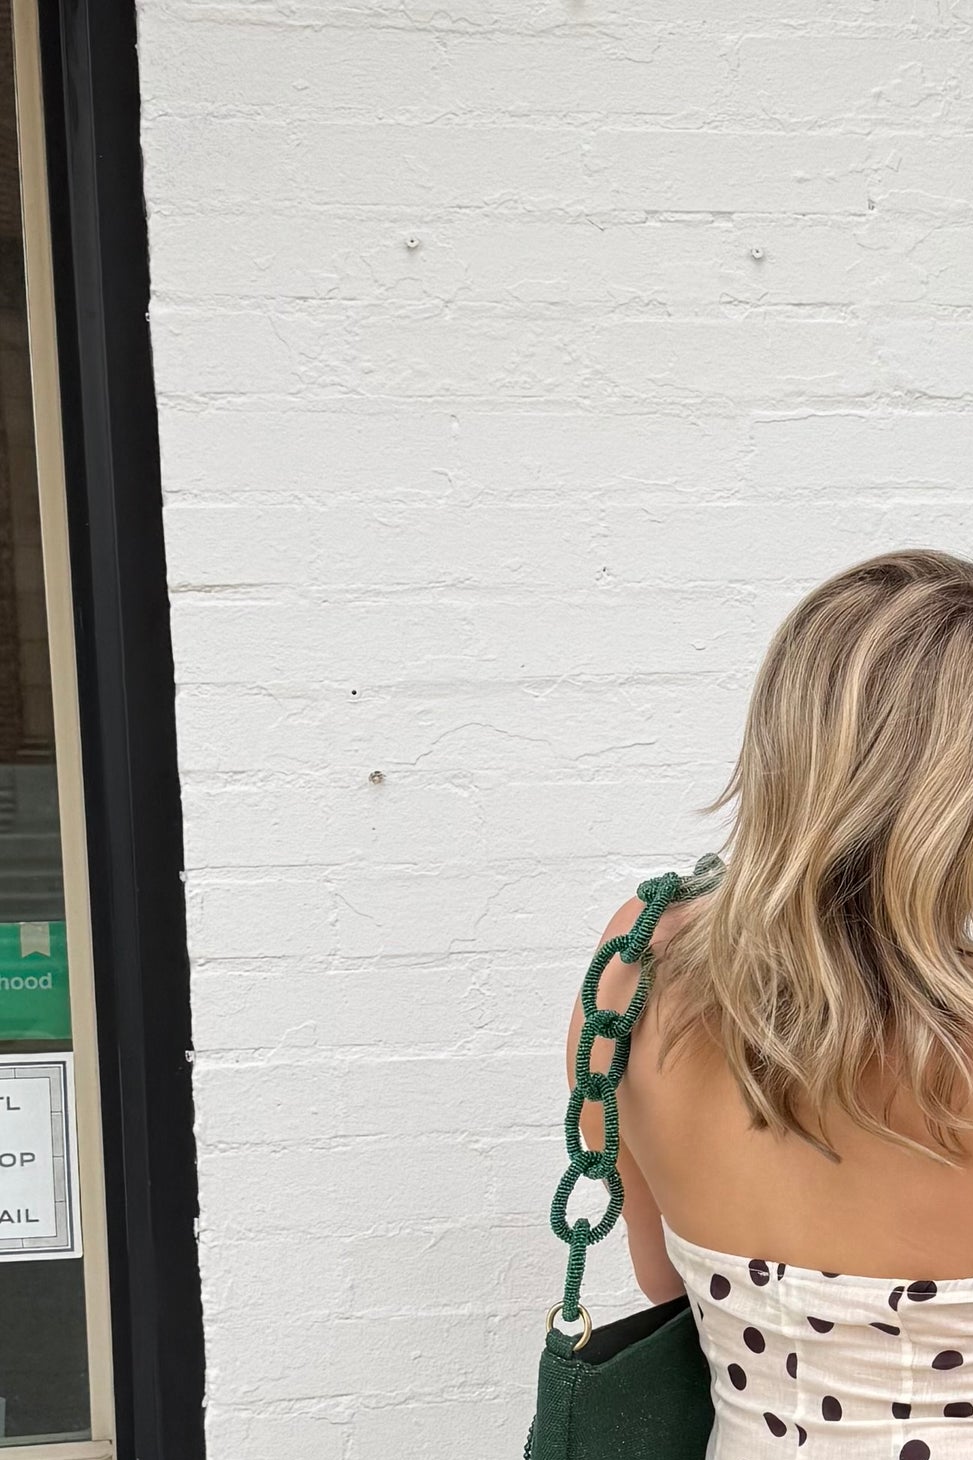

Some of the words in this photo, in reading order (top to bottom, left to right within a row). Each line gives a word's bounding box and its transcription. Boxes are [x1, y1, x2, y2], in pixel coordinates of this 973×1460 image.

[0, 1096, 21, 1111] L
[0, 1152, 36, 1167] OP
[0, 1209, 40, 1224] AIL
